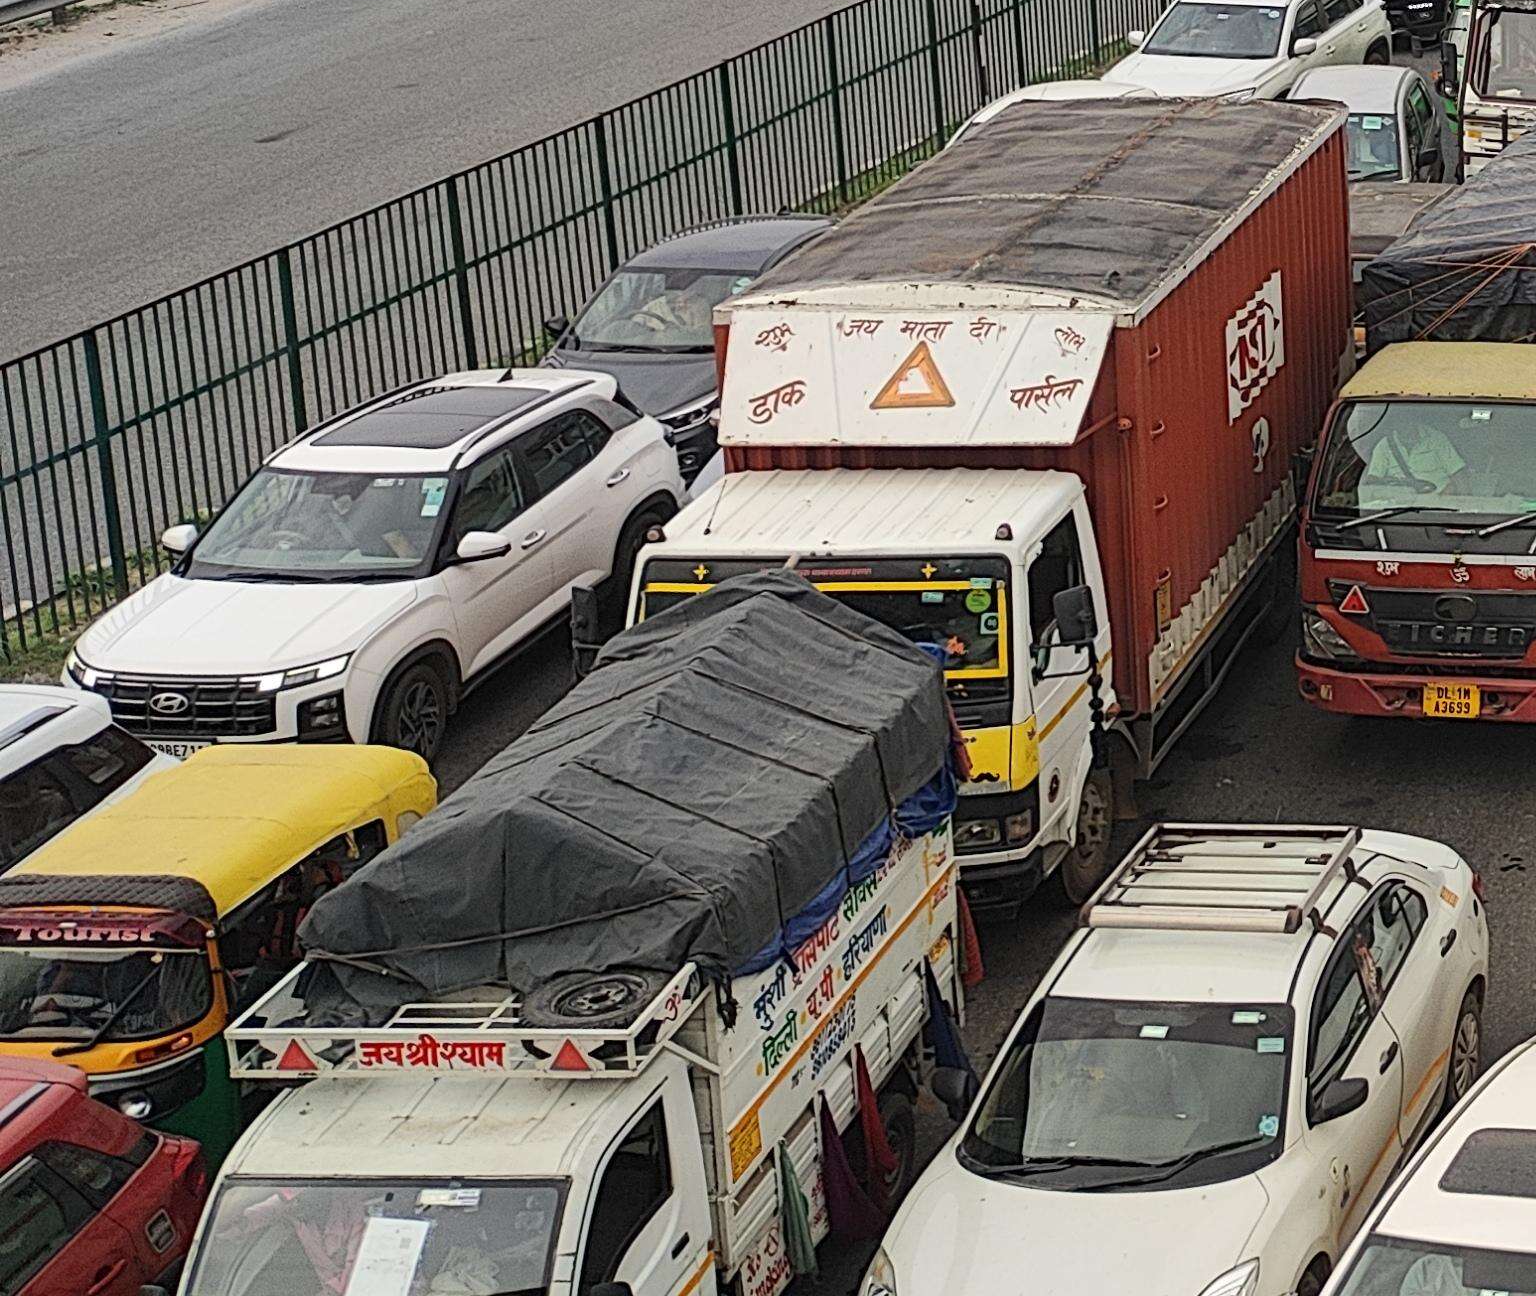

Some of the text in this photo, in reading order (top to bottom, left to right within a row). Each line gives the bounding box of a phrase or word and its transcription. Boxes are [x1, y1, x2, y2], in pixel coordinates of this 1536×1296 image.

[900, 319, 953, 344] माता
[748, 375, 1084, 424] डाक पार्सल
[1388, 623, 1526, 645] EICHER
[1436, 687, 1450, 699] DL
[13, 926, 155, 942] Tourist
[762, 1008, 798, 1077] दिल्ली
[841, 904, 887, 982] हरियाणा
